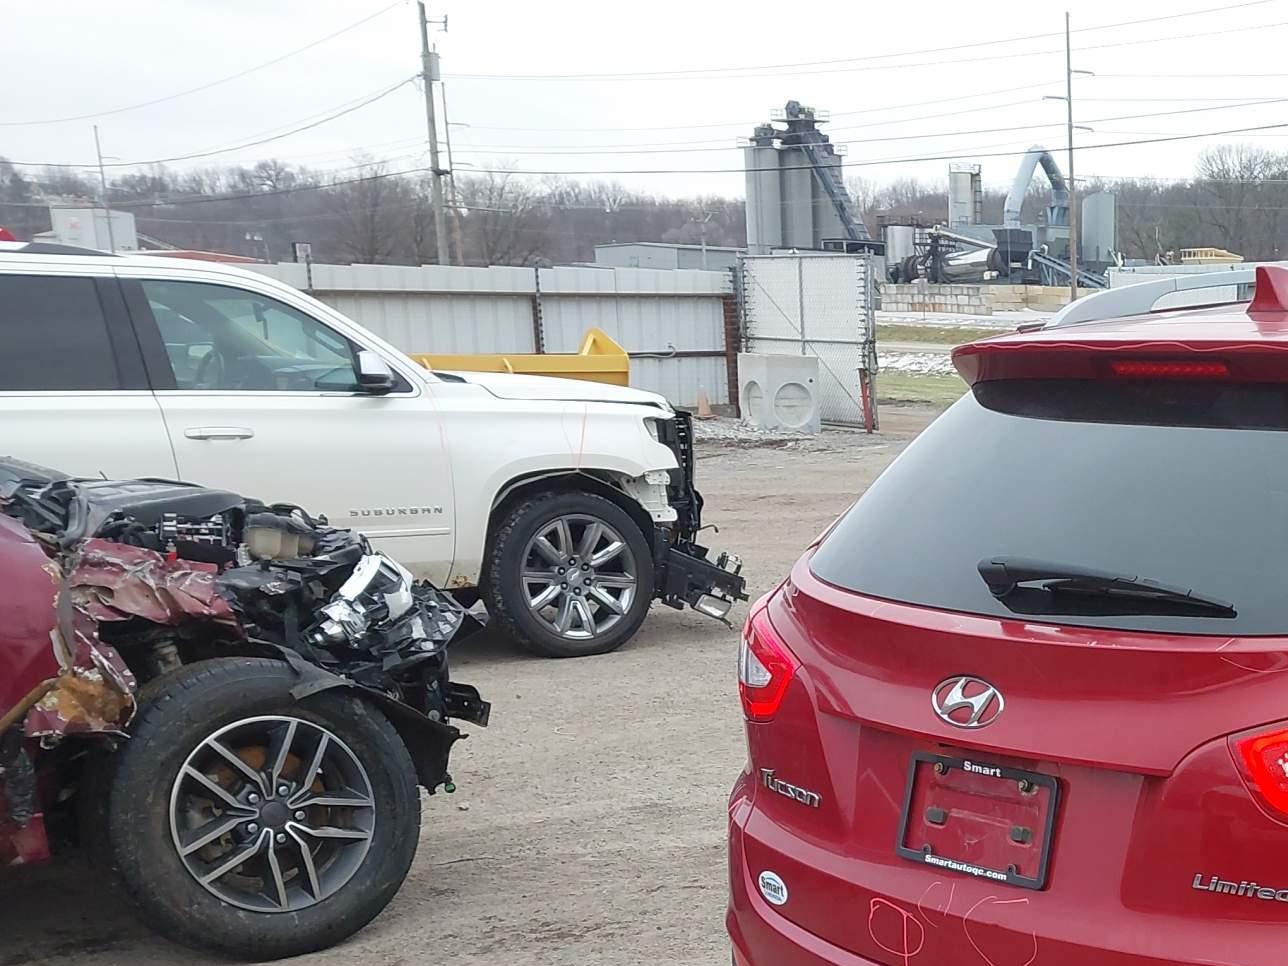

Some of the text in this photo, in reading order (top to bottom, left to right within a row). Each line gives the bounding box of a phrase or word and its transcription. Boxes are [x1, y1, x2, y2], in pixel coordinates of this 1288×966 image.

[350, 507, 443, 517] SUBURBAN
[963, 761, 1001, 777] Smart
[760, 768, 820, 807] Tucson
[924, 854, 1007, 881] Smartautoqc.com
[761, 875, 785, 898] Smart
